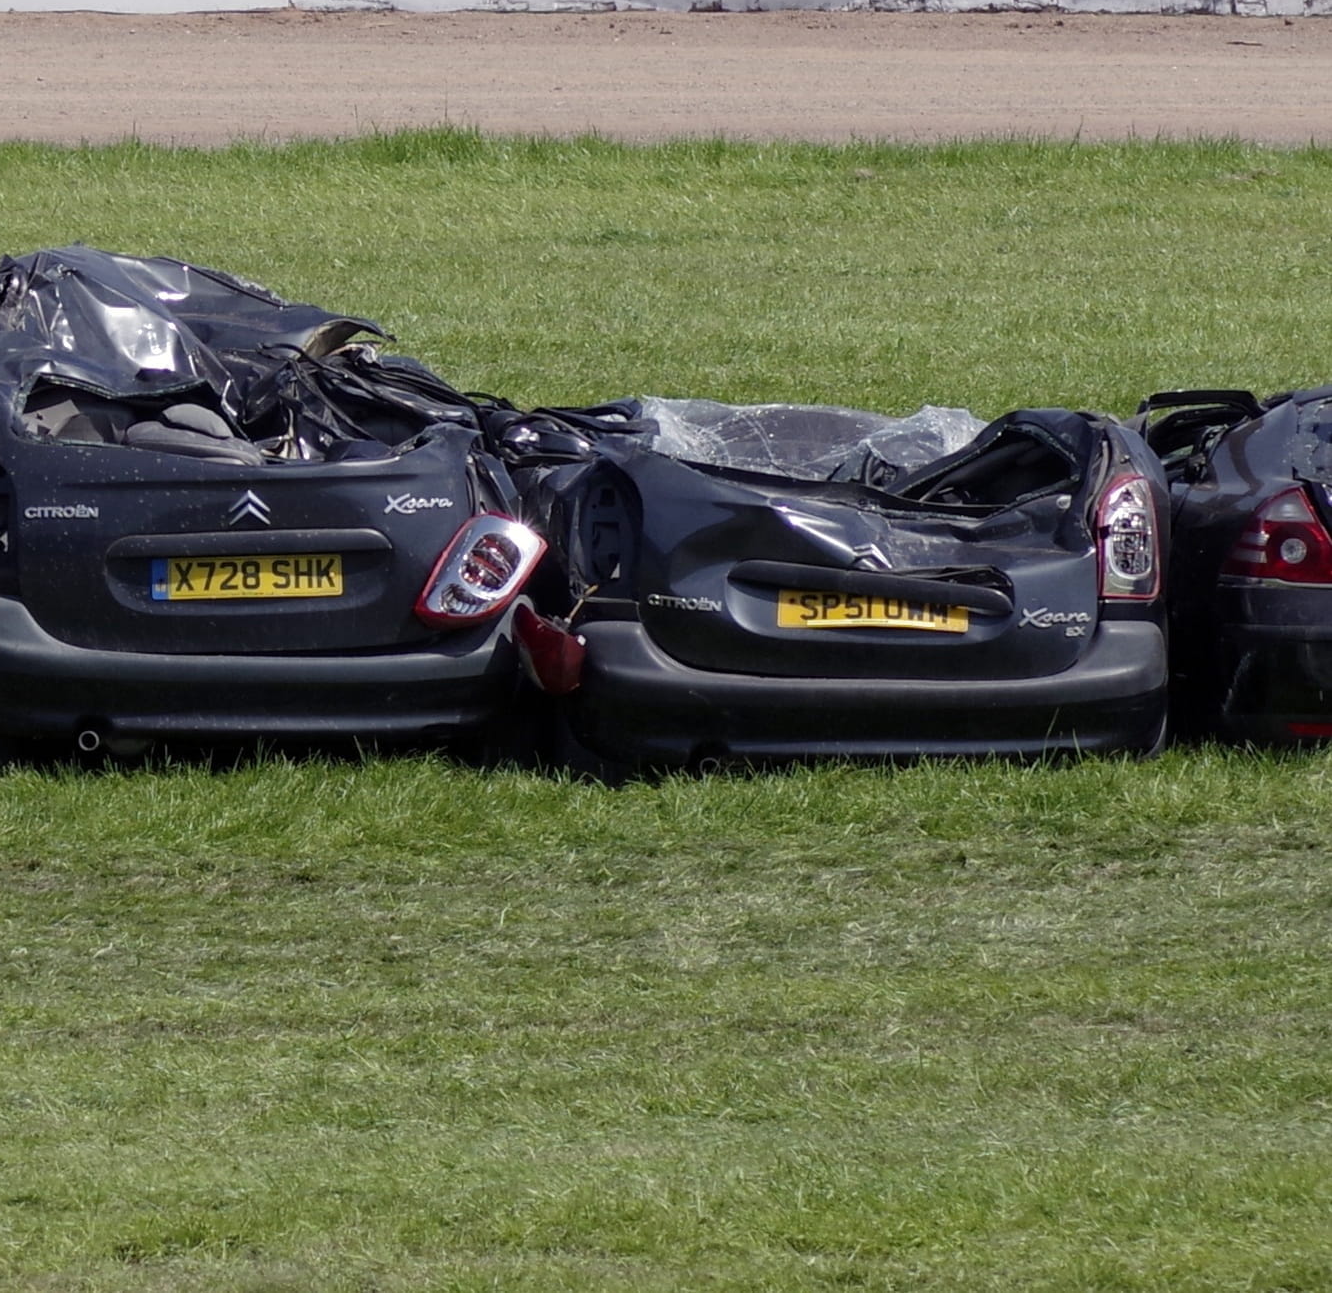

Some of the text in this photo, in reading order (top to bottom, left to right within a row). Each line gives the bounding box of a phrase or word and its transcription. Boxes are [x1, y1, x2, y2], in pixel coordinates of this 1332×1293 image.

[24, 505, 99, 519] CITROËN
[384, 493, 454, 515] Xsara
[174, 558, 337, 592] X728 SHK
[647, 592, 723, 612] CITROËN
[799, 593, 873, 621] SP51
[1018, 608, 1092, 628] Xsara
